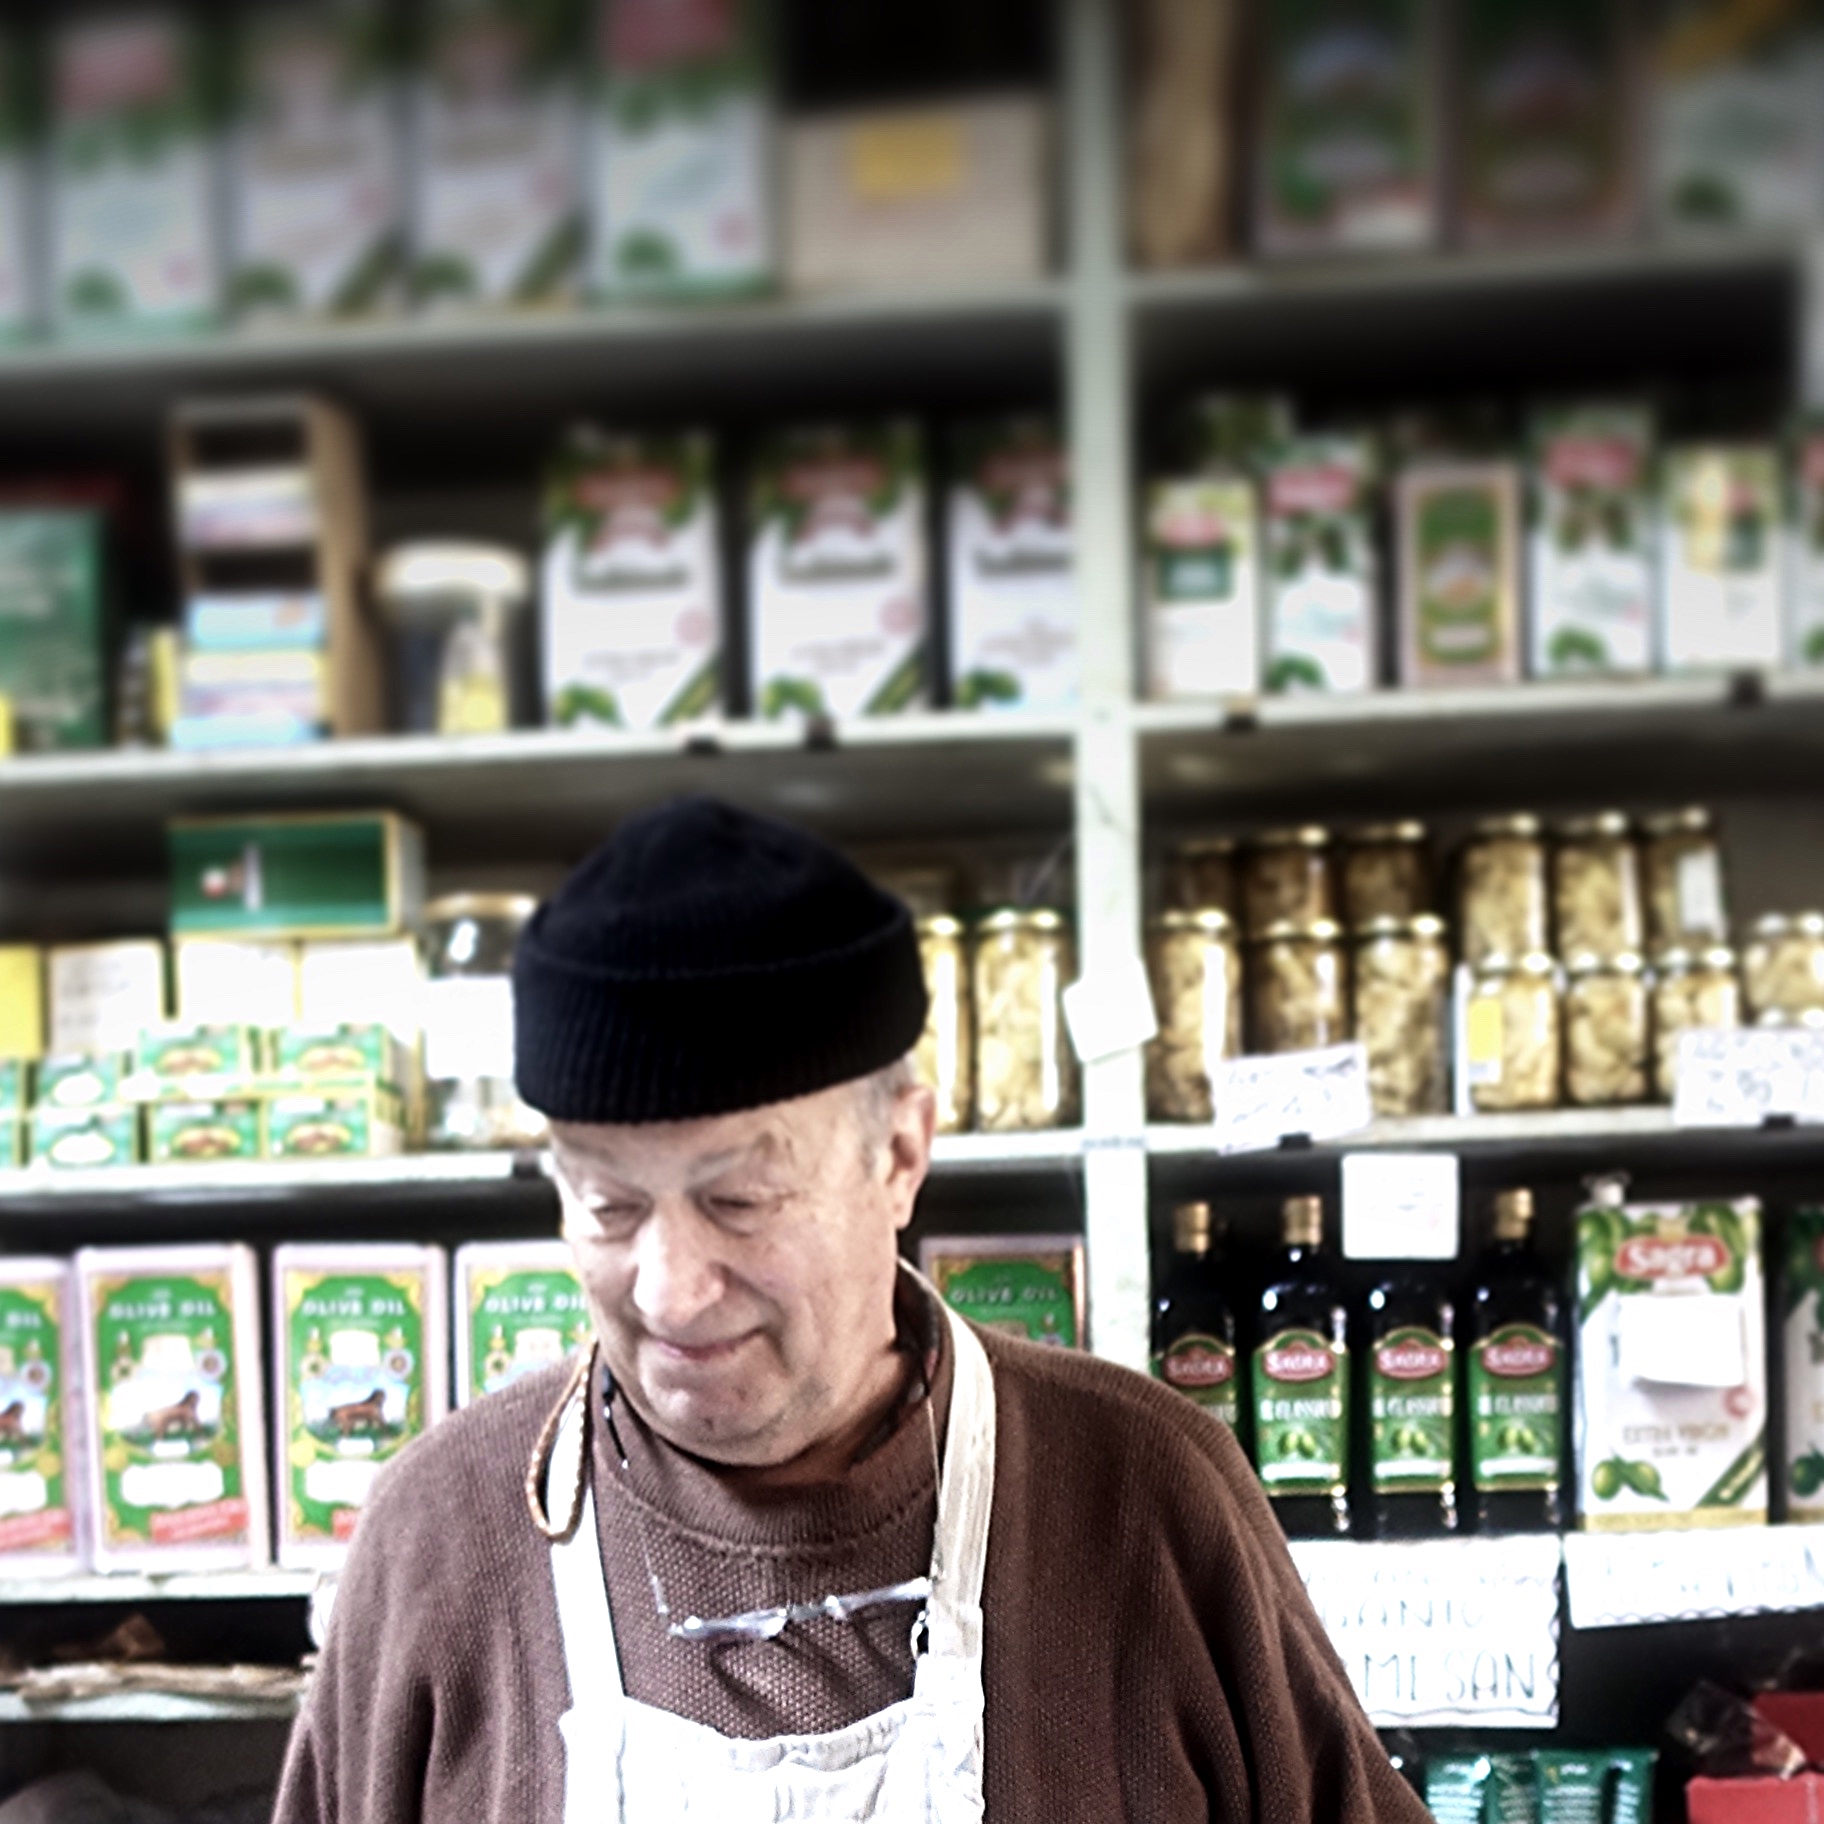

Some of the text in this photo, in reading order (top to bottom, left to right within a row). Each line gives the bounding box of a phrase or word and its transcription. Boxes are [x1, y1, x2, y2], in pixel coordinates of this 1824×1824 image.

[951, 1286, 1057, 1303] OLIVE OIL
[109, 1300, 216, 1319] OLIVE OIL
[302, 1298, 406, 1316] OLIVE OIL
[485, 1296, 545, 1313] OLIVE
[5, 1312, 42, 1328] OIL
[1352, 1649, 1536, 1702] MI SAN
